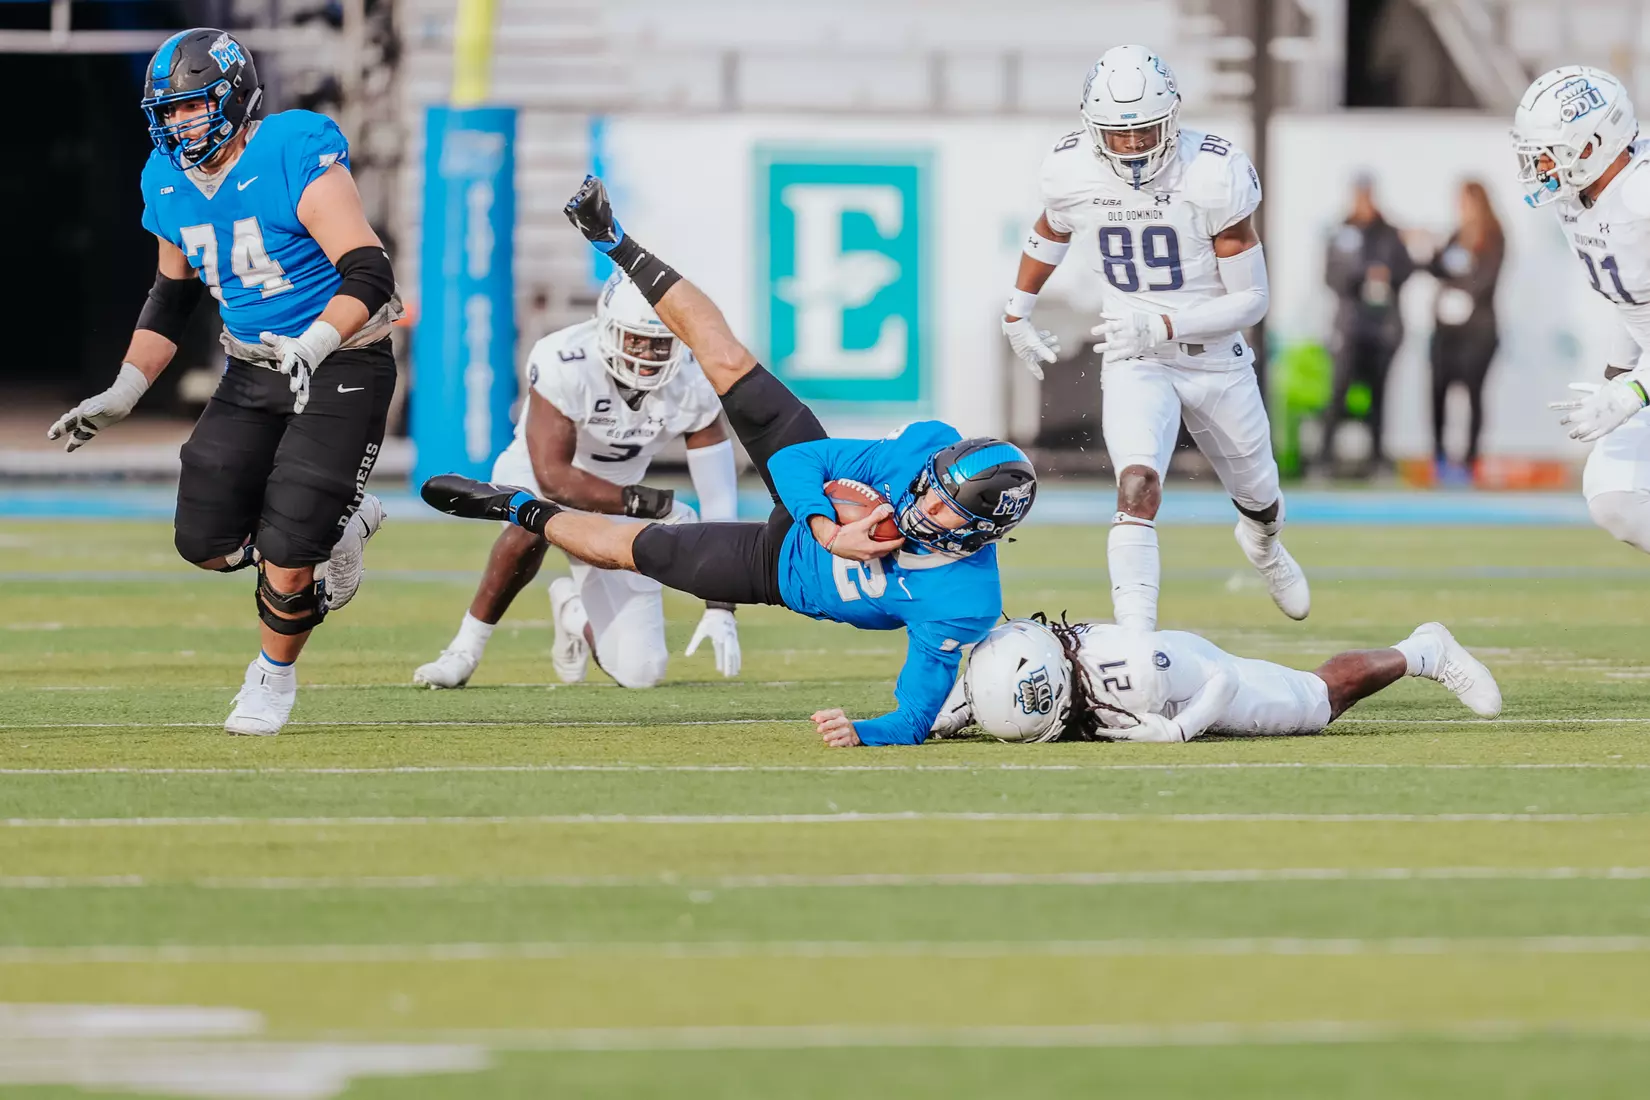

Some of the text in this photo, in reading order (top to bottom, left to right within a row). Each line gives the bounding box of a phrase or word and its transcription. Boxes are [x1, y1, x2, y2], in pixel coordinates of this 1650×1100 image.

[1561, 87, 1607, 124] ODU
[1108, 209, 1163, 221] OLD DOMINION
[180, 216, 294, 309] 74
[1099, 226, 1184, 292] 89
[773, 182, 908, 381] E
[557, 348, 586, 362] 3
[595, 399, 611, 413] C
[1031, 665, 1053, 715] ODU
[1099, 660, 1132, 692] 21
